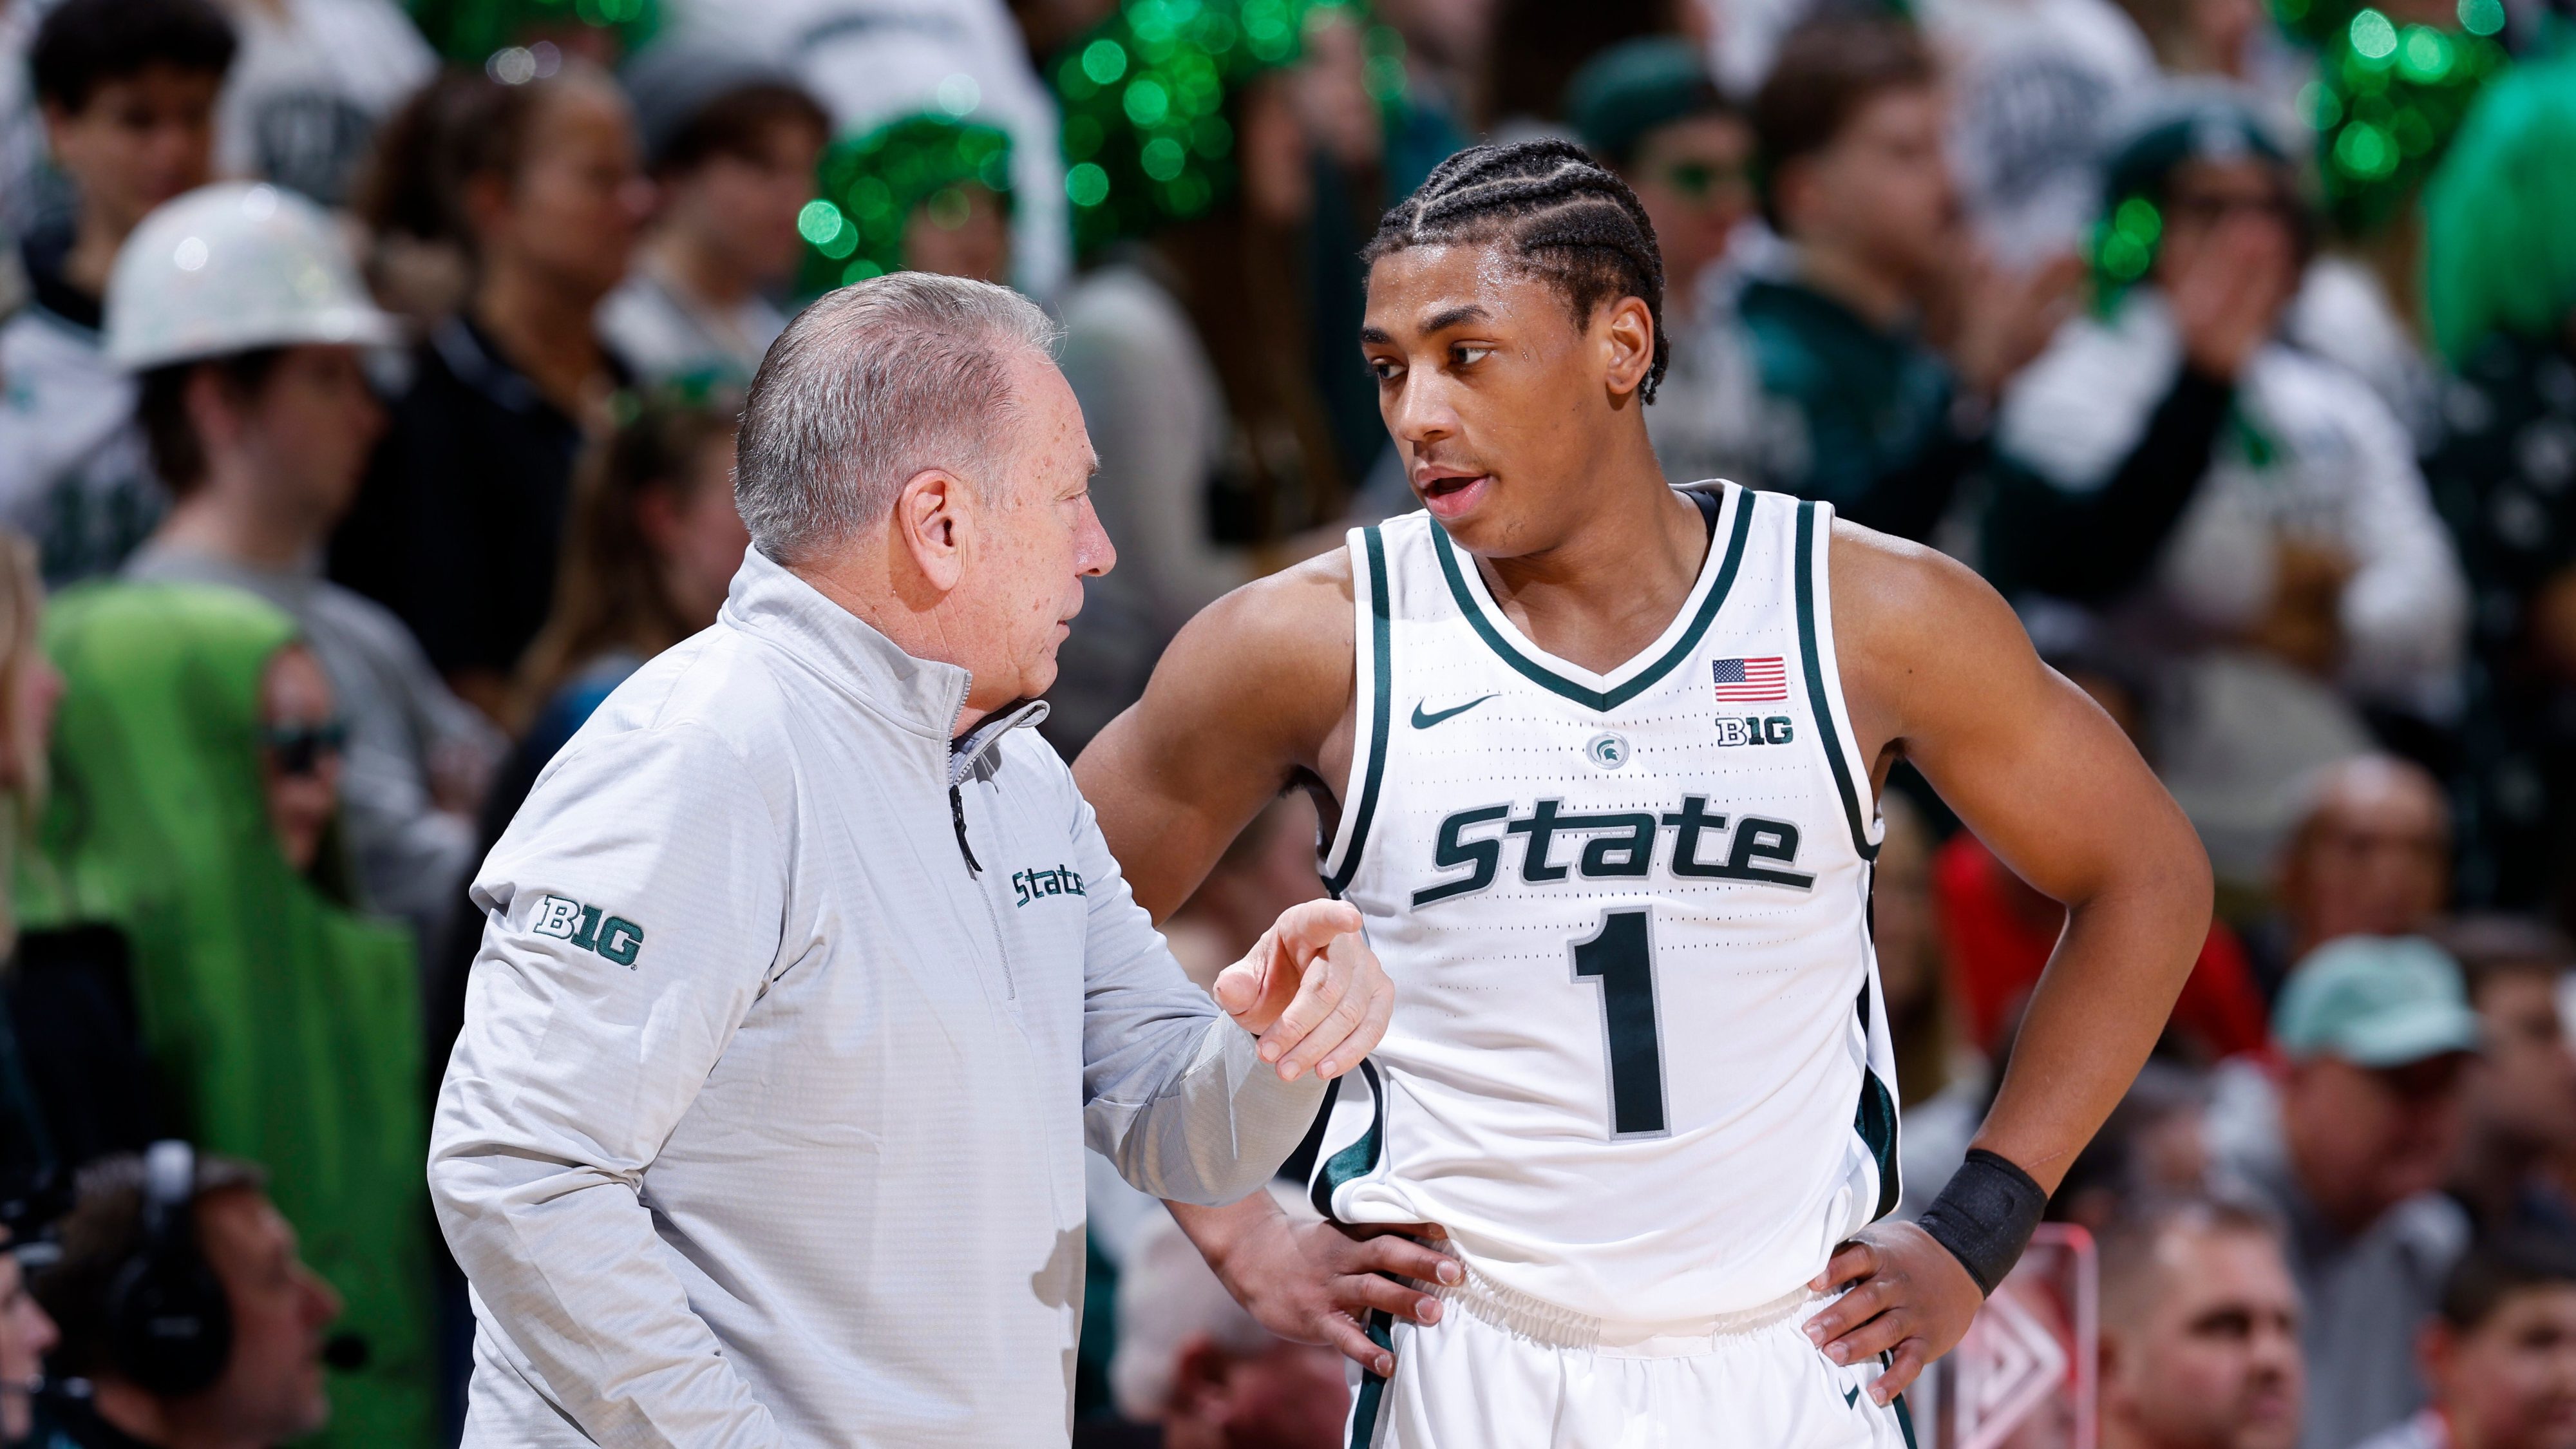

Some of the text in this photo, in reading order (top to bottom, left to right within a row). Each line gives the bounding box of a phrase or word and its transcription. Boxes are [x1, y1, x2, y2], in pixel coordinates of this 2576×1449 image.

[1012, 864, 1087, 909] State
[1410, 793, 1817, 913] State
[1566, 904, 1672, 1141] 1
